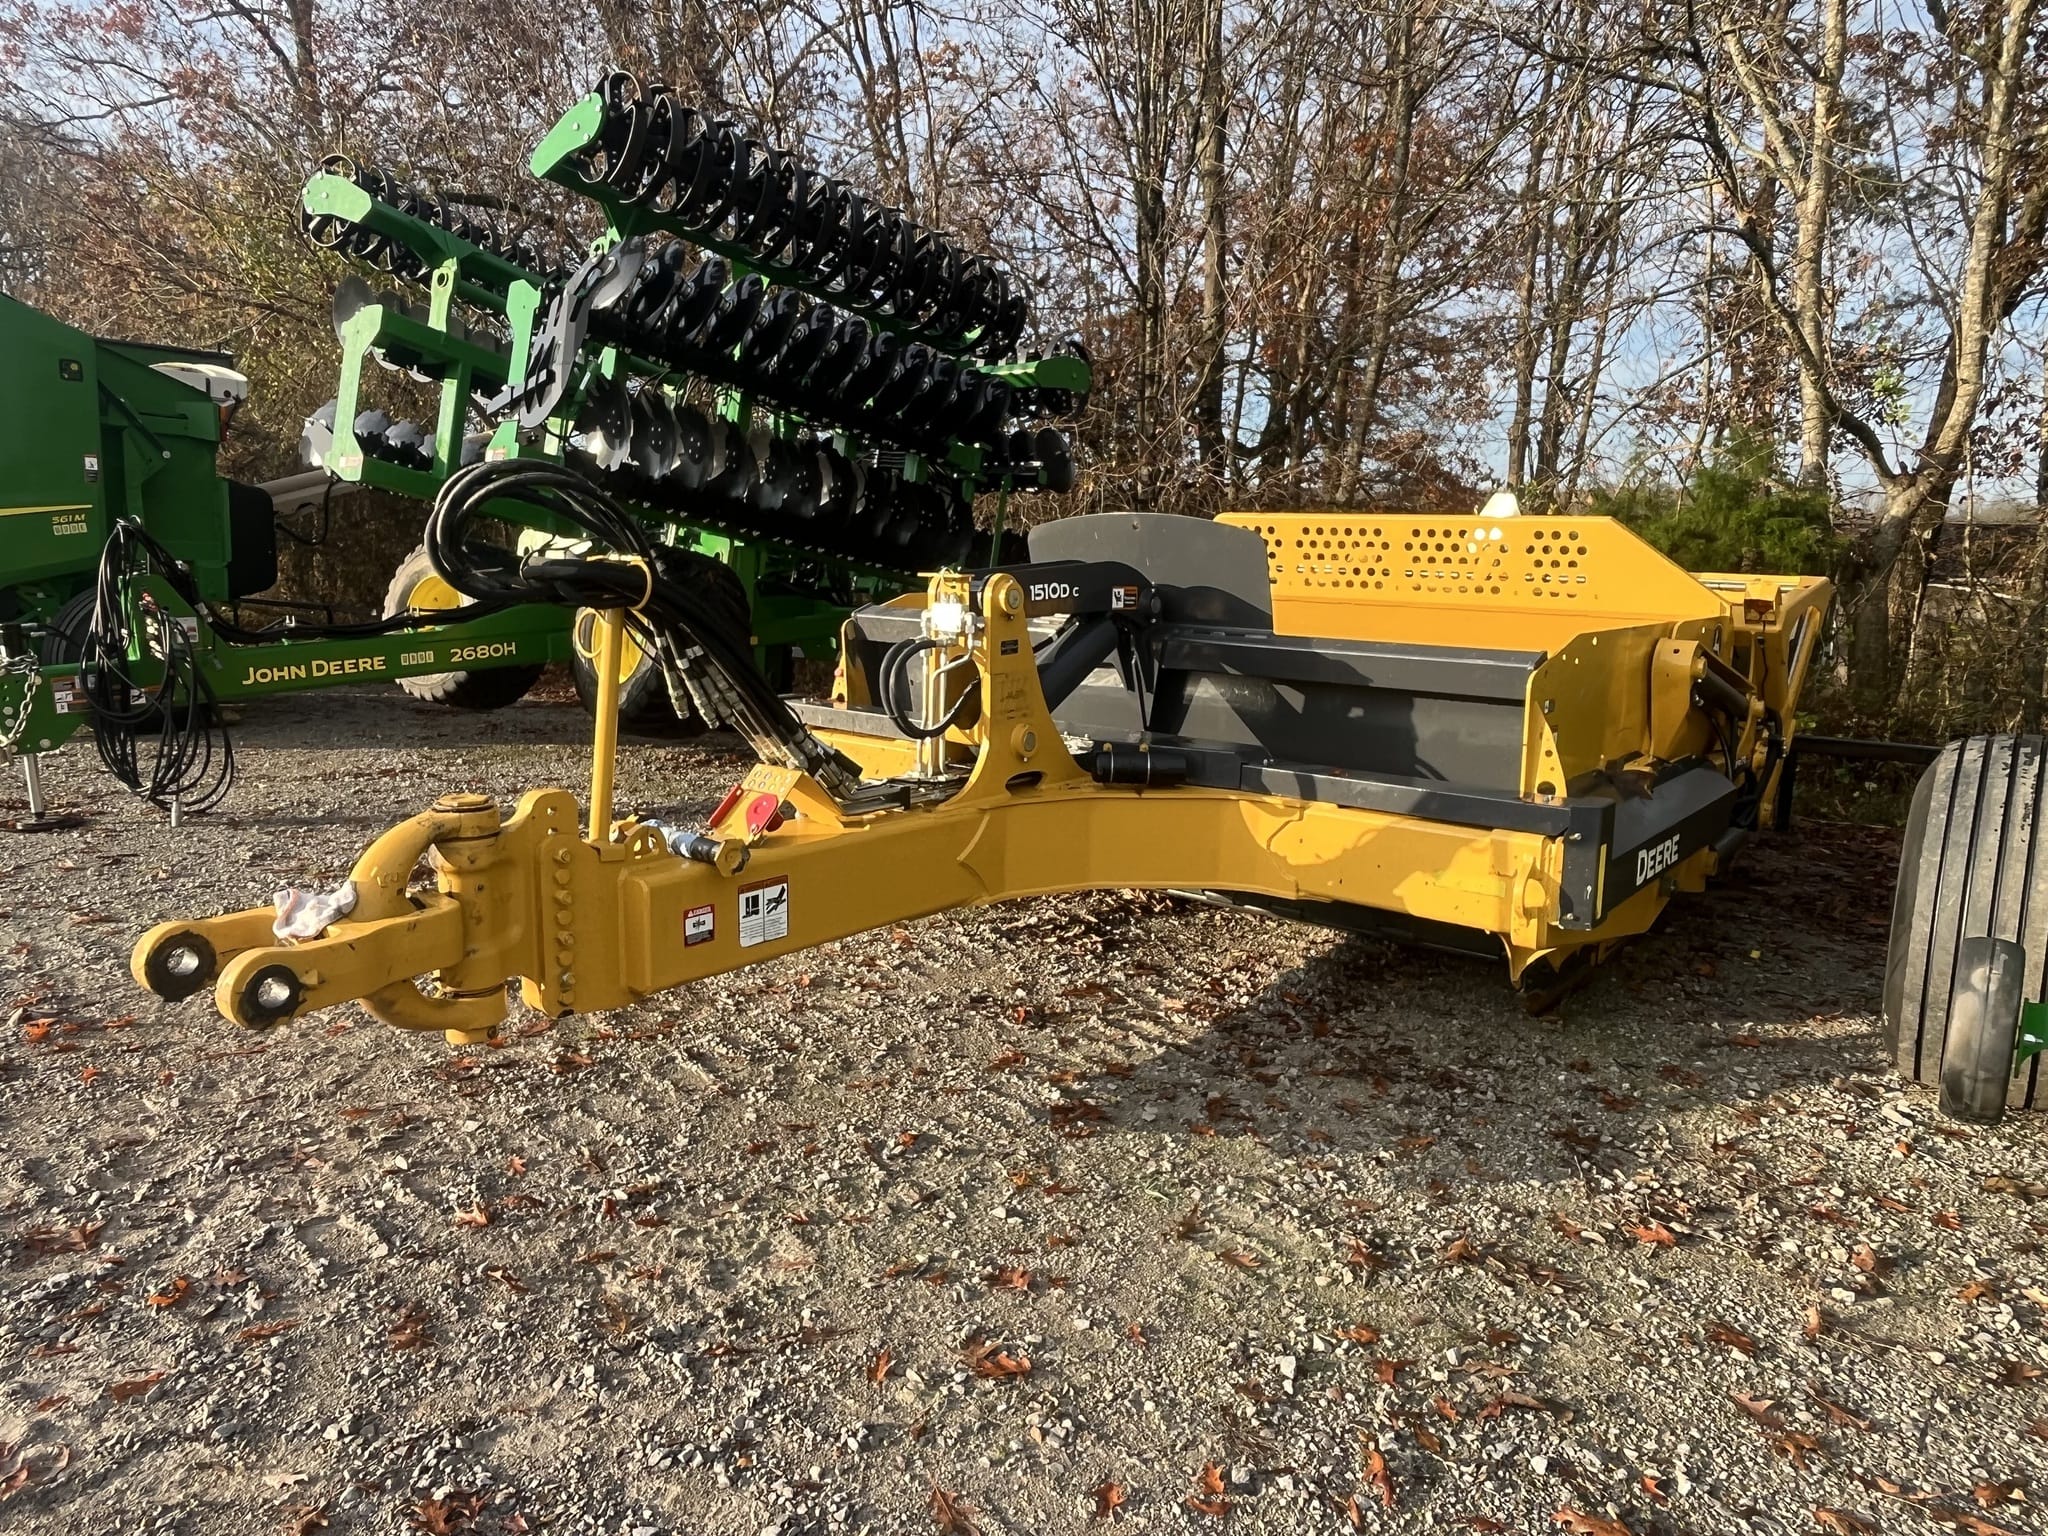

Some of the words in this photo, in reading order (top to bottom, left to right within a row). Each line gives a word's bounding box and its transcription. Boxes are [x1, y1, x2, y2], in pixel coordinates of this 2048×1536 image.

[52, 514, 86, 524] 561M
[1029, 582, 1070, 602] 1510D
[242, 665, 307, 685] JOHN
[311, 656, 386, 677] DEERE
[450, 642, 516, 663] 2680H
[1636, 833, 1681, 886] DEERE
